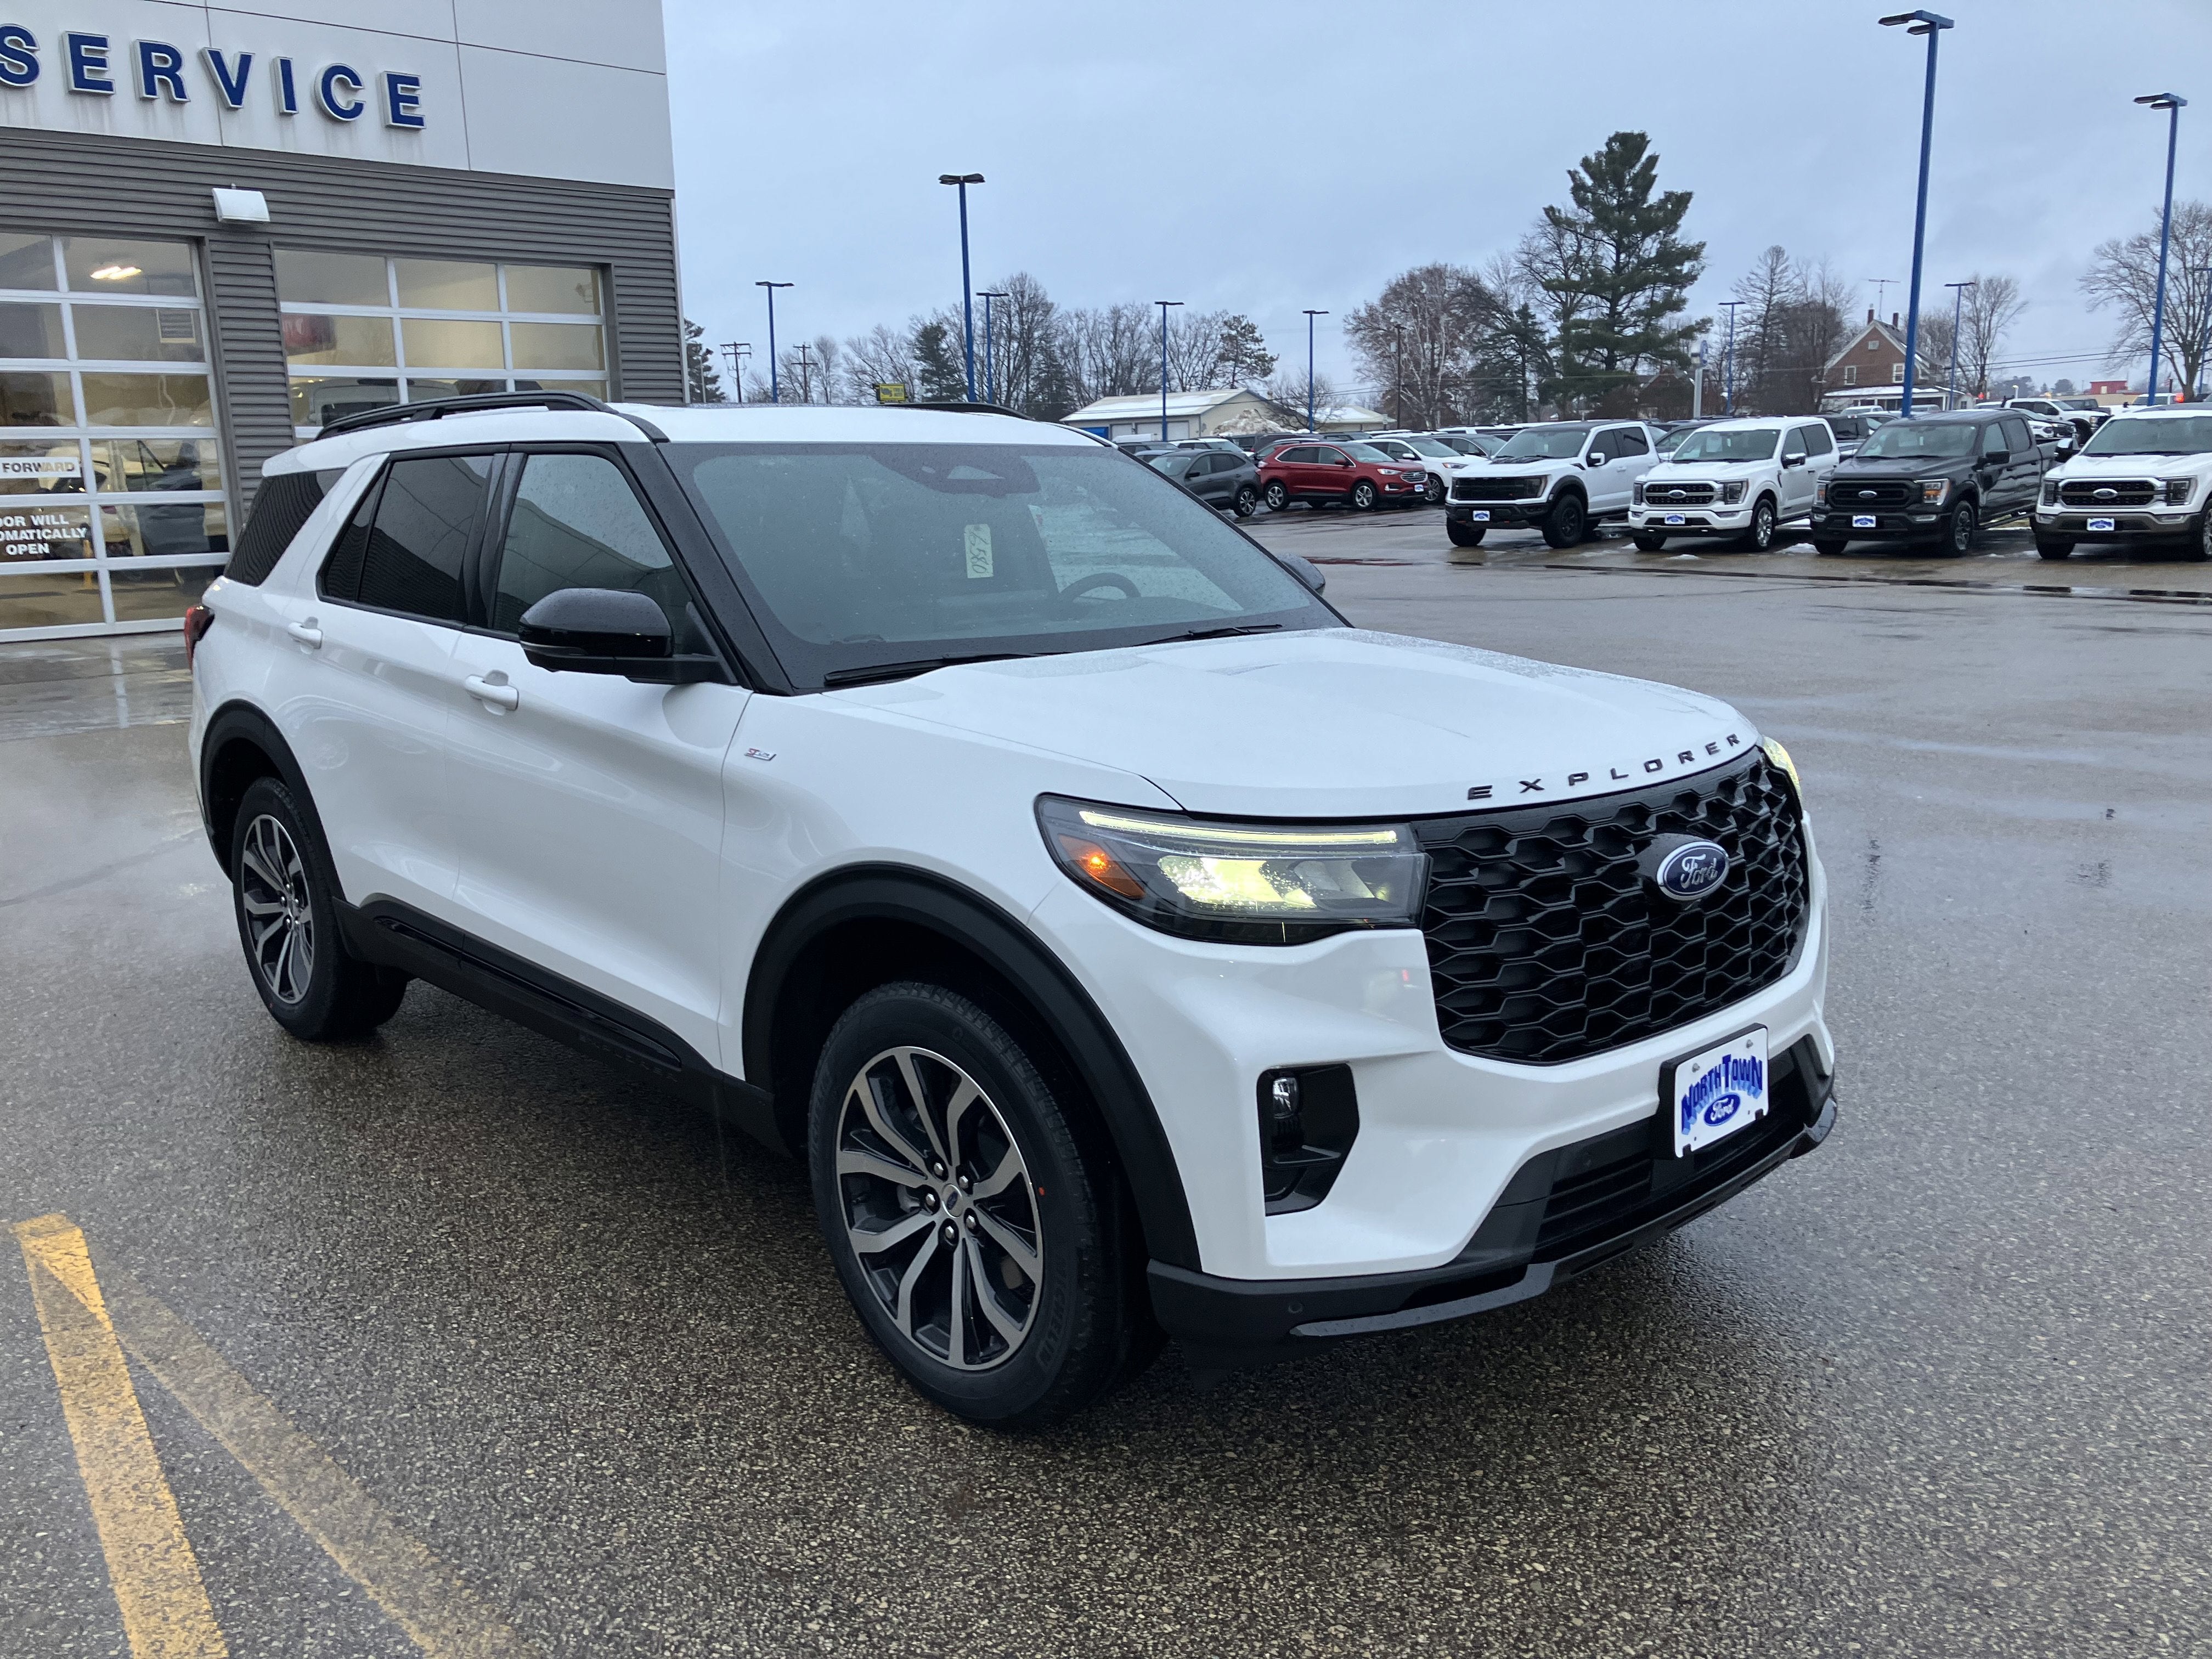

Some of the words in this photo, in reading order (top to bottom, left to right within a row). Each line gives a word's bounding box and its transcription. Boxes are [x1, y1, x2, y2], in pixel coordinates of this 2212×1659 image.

[0, 24, 426, 130] SERVICE
[2, 462, 75, 473] FORWARD
[0, 516, 26, 527] OOR
[30, 514, 69, 526] WILL
[6, 543, 50, 555] OPEN
[1468, 733, 1740, 800] EXPLORER
[1680, 853, 1718, 889] Ford
